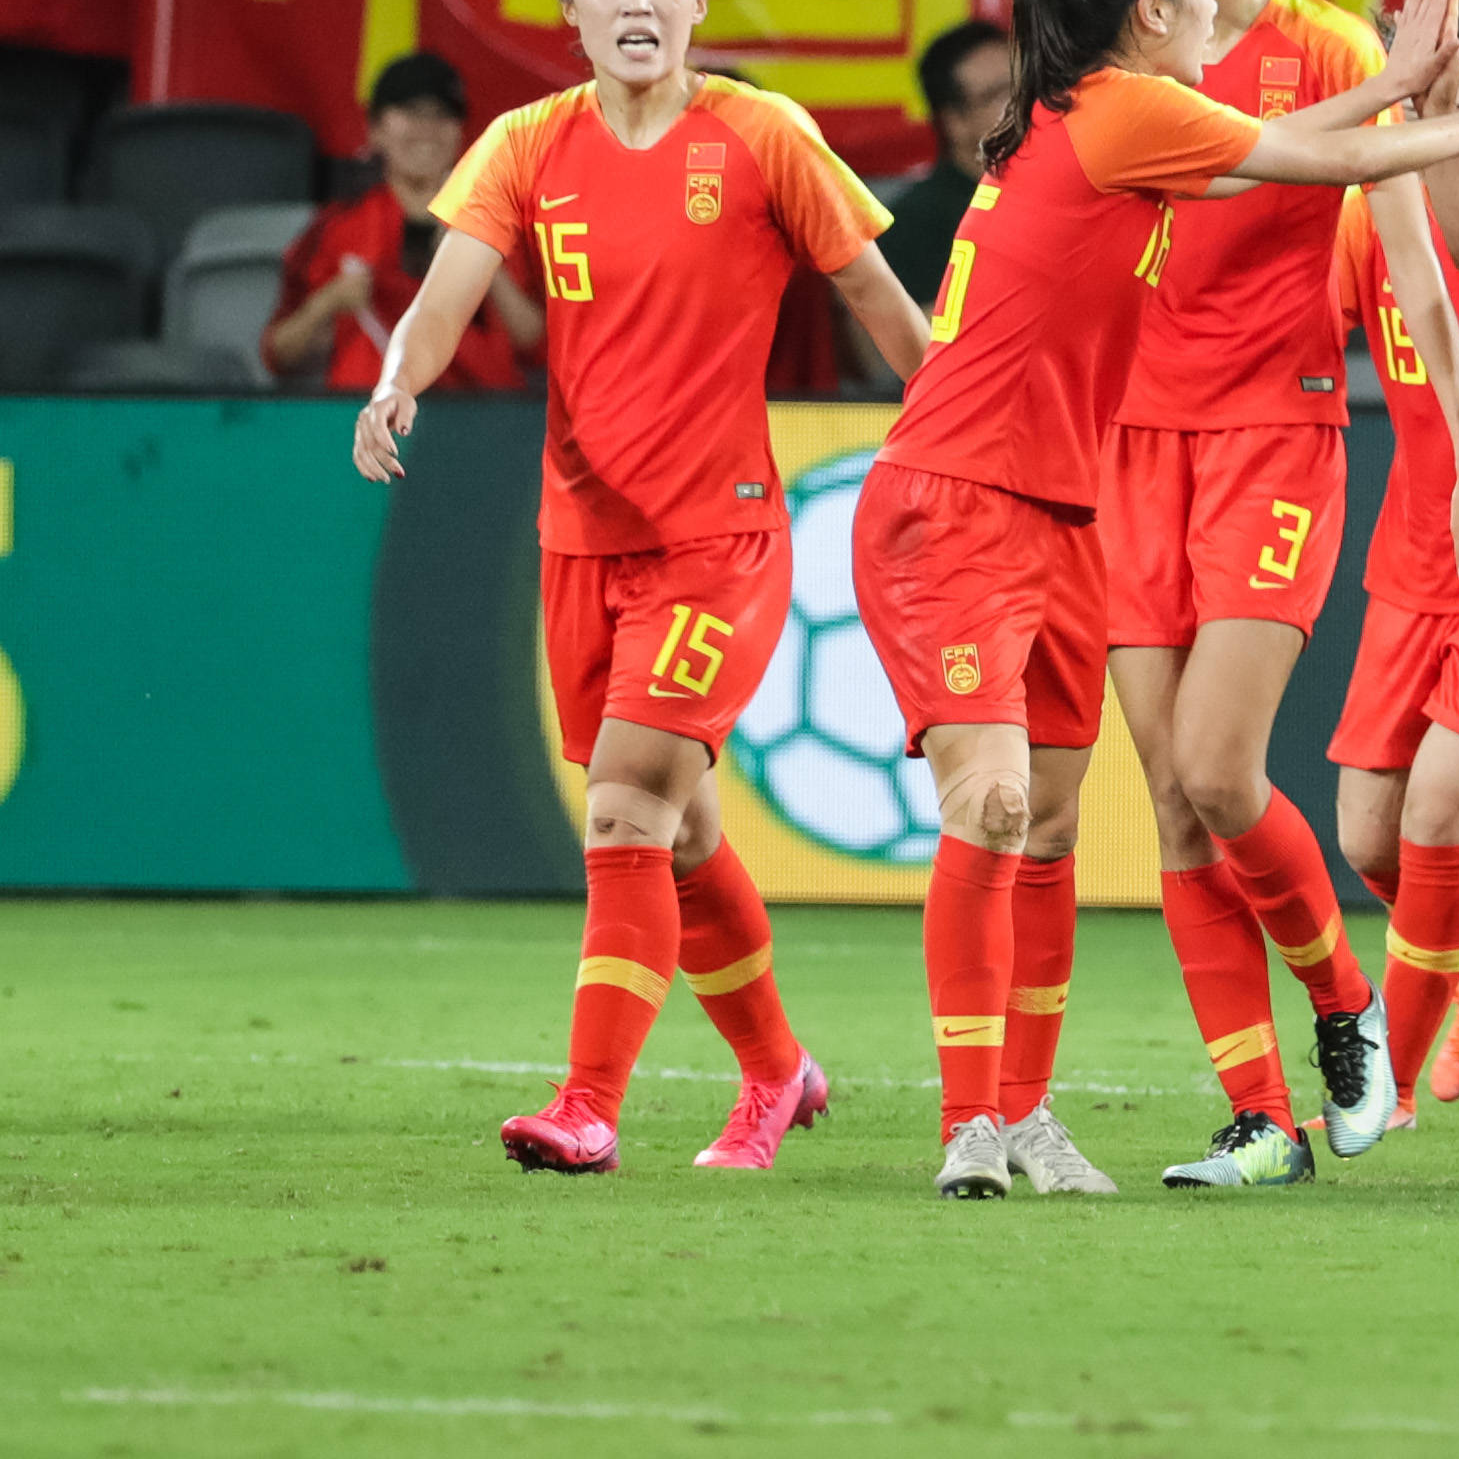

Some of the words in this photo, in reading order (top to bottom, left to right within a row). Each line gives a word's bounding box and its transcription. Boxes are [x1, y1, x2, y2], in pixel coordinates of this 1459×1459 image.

[534, 223, 594, 302] 15
[1258, 499, 1312, 580] 3
[651, 604, 734, 697] 15
